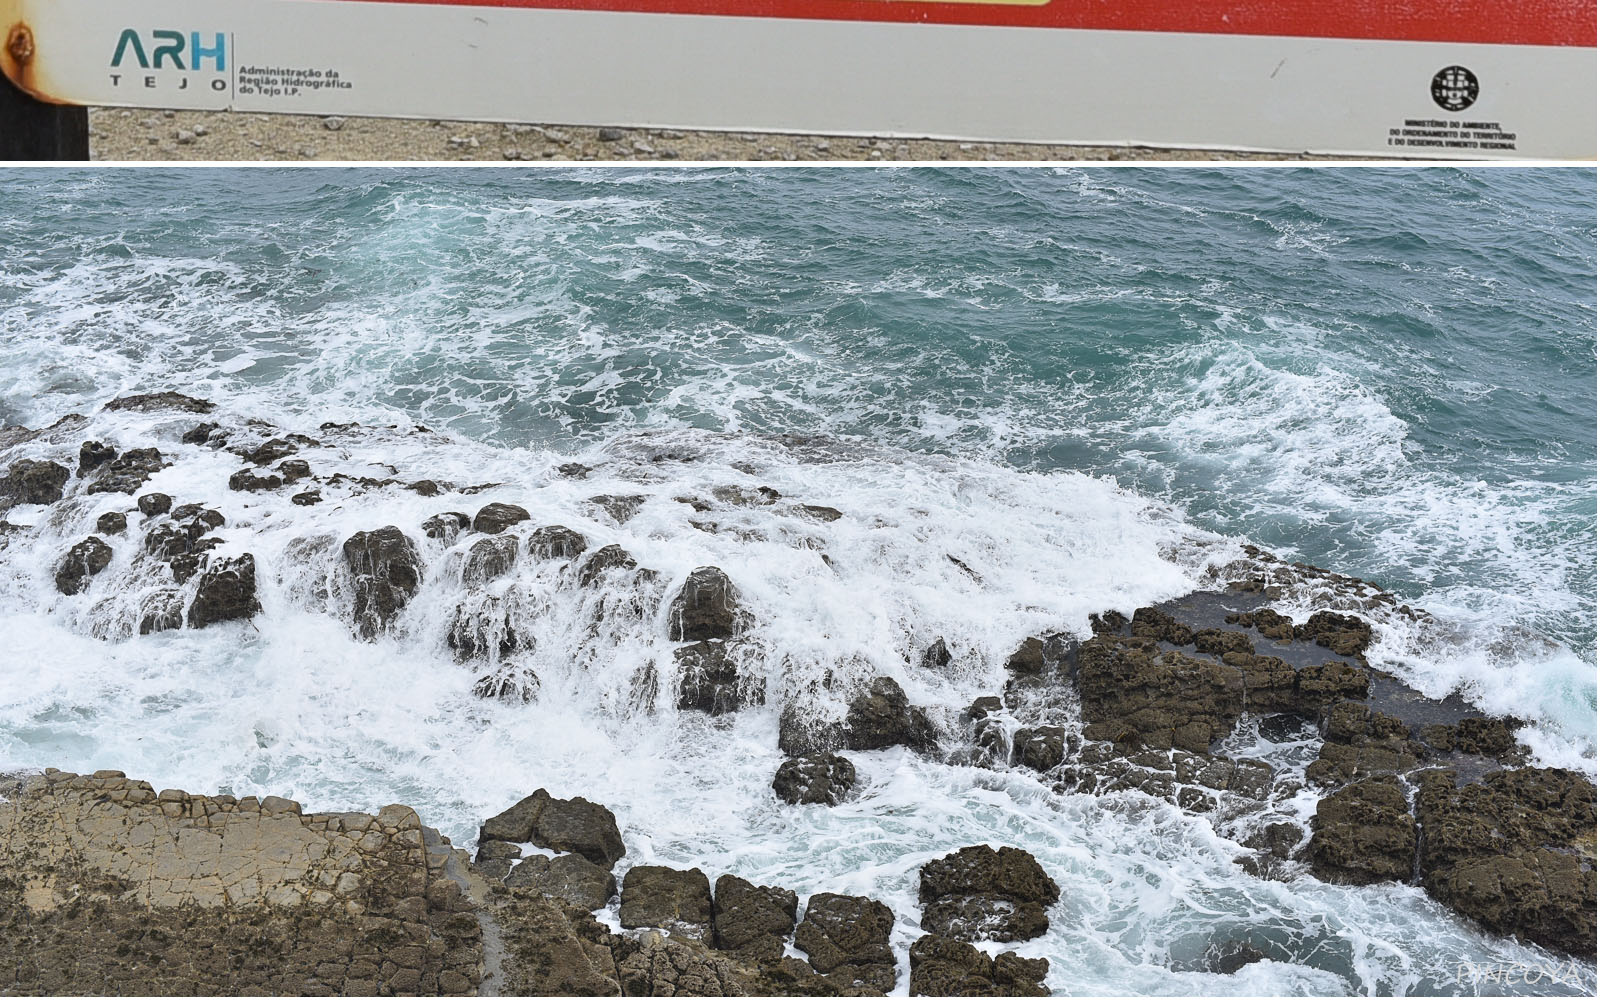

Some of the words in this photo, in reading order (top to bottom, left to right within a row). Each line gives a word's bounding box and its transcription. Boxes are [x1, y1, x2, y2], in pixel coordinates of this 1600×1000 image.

[110, 28, 226, 72] ARH
[239, 65, 321, 80] Administração
[325, 69, 339, 79] da
[239, 76, 278, 89] Região
[281, 76, 353, 90] Hidrográfica
[239, 85, 253, 95] do
[257, 86, 281, 97] Tejo
[284, 87, 301, 97] I.P.
[1404, 118, 1448, 128] MINISTÉRIO
[1389, 128, 1400, 136] DO
[1402, 129, 1458, 138] ORDENAMENTO
[1395, 138, 1405, 146] DO
[1407, 139, 1478, 149] DESENVOLVIMENTO
[1480, 141, 1517, 150] REGIONAL
